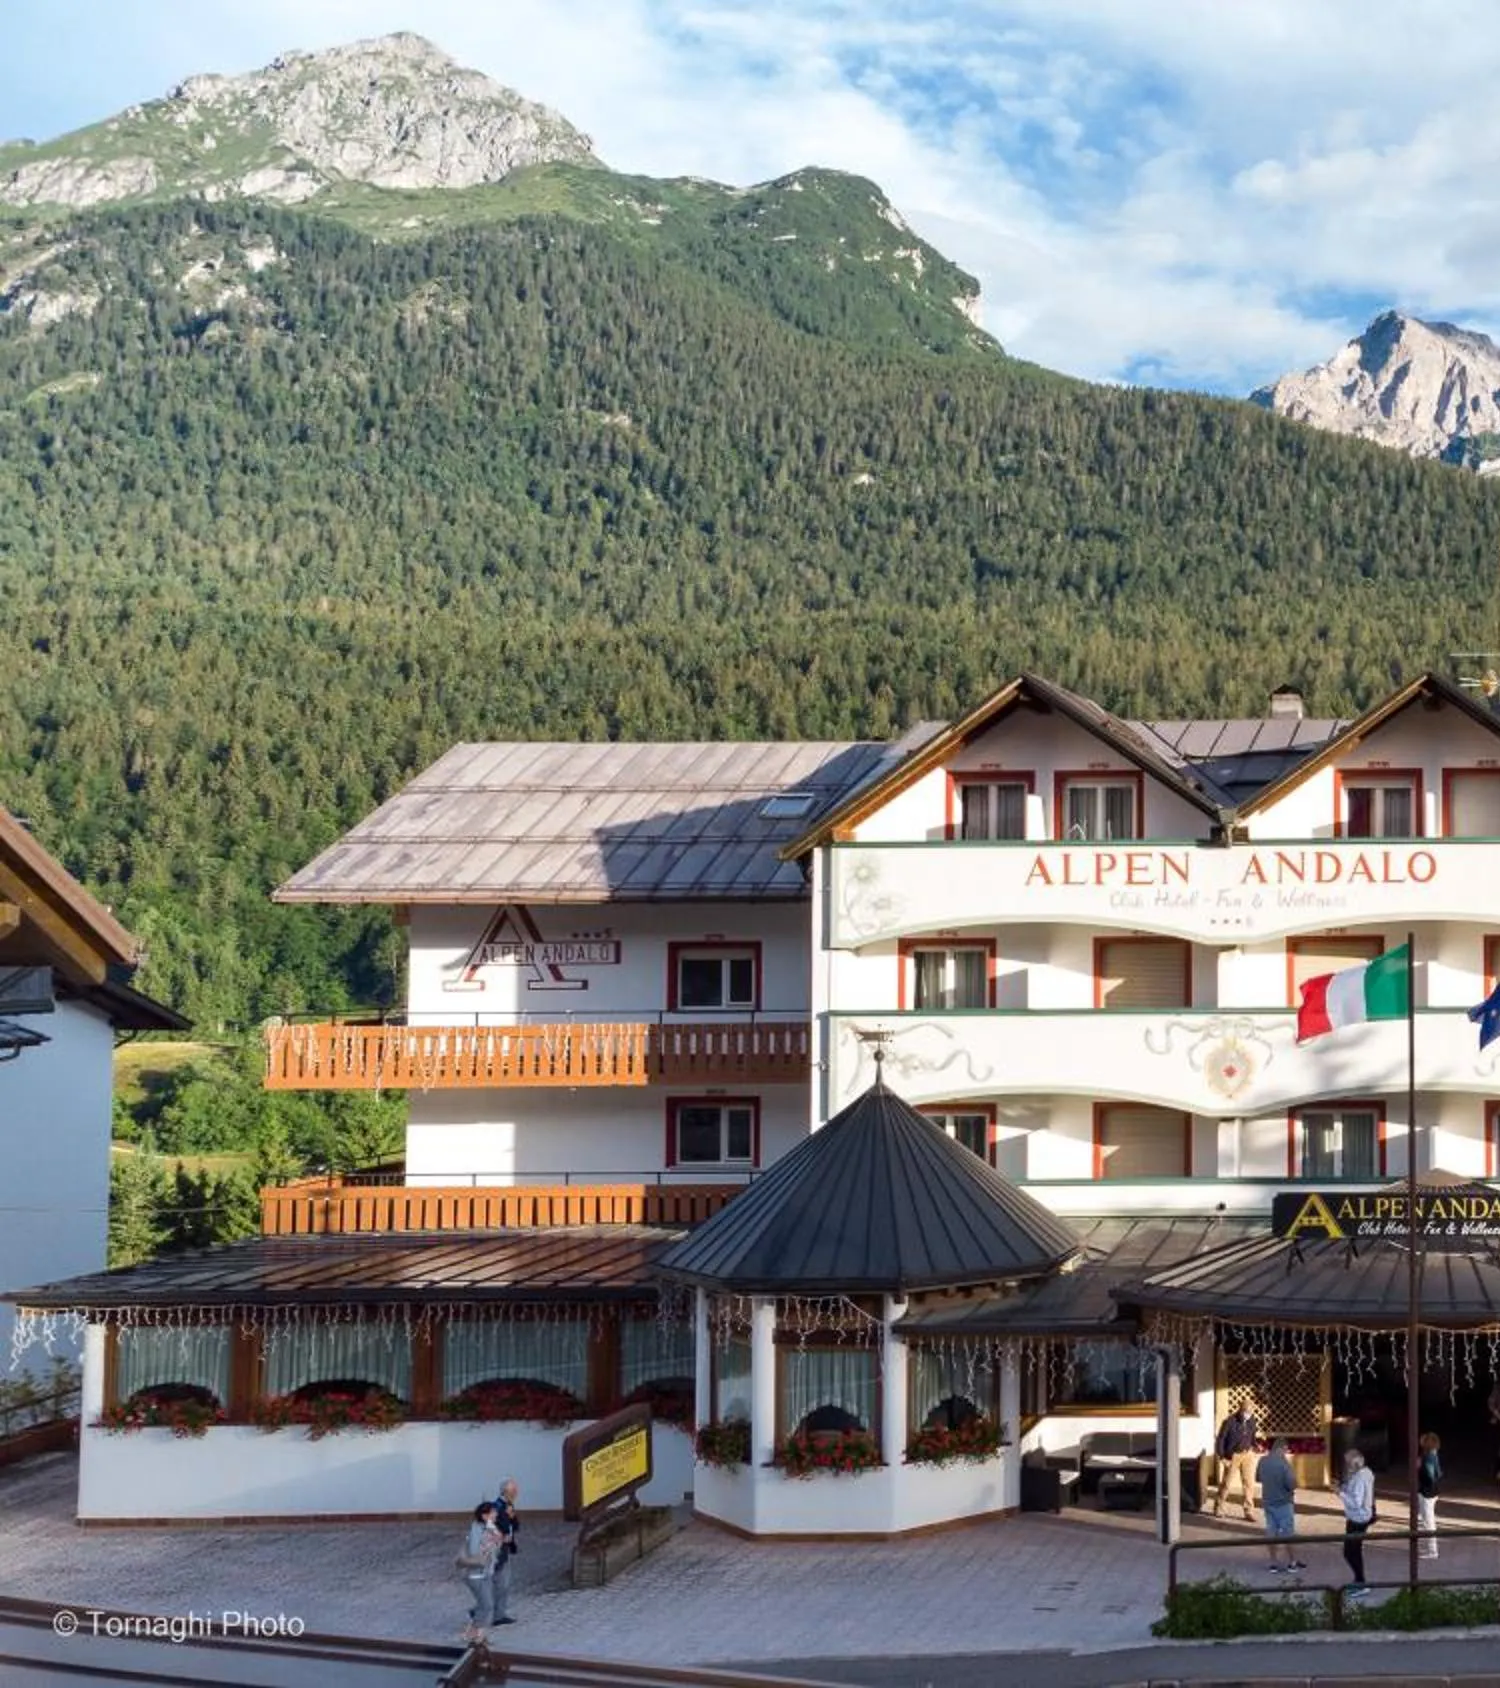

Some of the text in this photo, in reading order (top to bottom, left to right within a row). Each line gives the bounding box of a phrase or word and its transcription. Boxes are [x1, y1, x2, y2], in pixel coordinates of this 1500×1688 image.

[1024, 851, 1437, 886] ALPEN ANDALO
[1110, 890, 1144, 909] Club
[1154, 888, 1199, 908] Hotel
[1216, 888, 1242, 908] Fun
[479, 942, 609, 963] ALPEN ANDALO
[1337, 1197, 1425, 1219] ALPEN
[1357, 1221, 1381, 1235] Club
[1424, 1221, 1441, 1235] Fun
